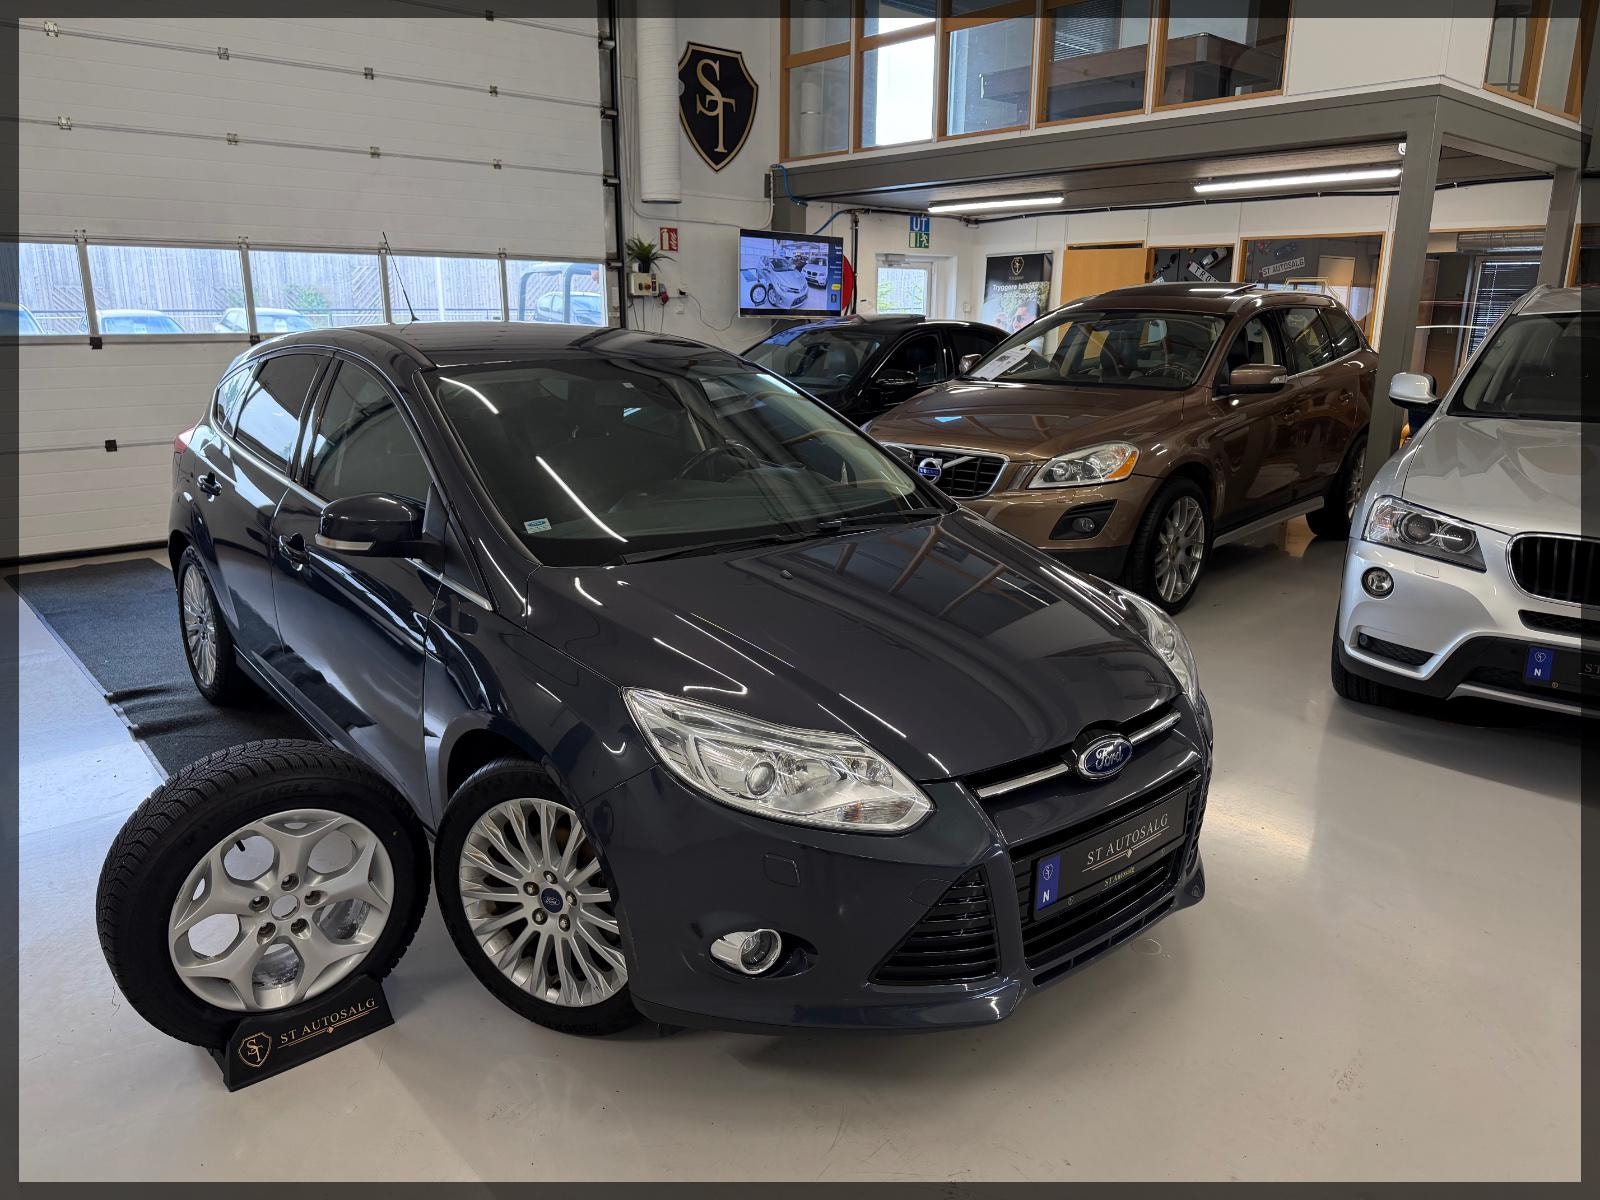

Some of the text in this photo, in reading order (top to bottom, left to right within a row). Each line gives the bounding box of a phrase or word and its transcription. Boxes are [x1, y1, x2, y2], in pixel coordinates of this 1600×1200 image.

[696, 59, 736, 152] ST
[912, 216, 928, 231] UT
[1194, 266, 1216, 282] TRO
[1263, 258, 1304, 276] ST AUTOSALG
[1534, 667, 1541, 676] N
[1095, 745, 1123, 771] Ford
[1087, 813, 1169, 865] ST AUTOSALG
[1042, 889, 1050, 903] N
[280, 998, 376, 1044] ST AUTOSALG
